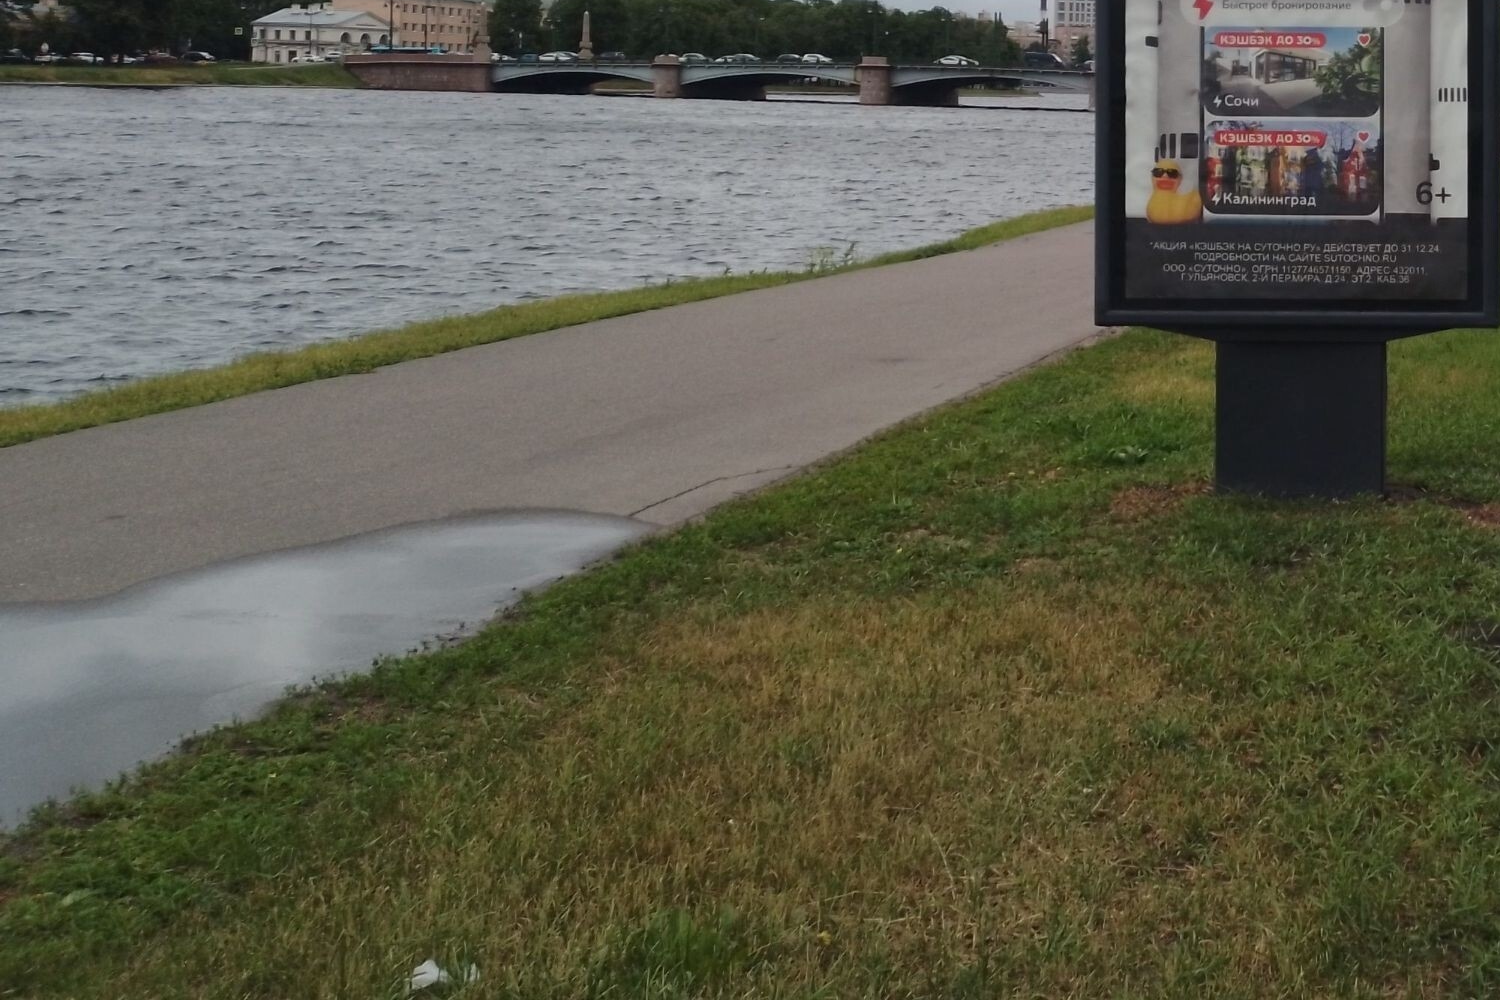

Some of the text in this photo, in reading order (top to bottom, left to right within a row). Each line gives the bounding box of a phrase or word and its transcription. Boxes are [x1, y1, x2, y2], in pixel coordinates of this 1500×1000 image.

[1222, 0, 1352, 11] Быстрое бронирование
[1219, 34, 1321, 46] КЭШБЭК ДО 30%
[1223, 94, 1259, 108] Сочи
[1219, 133, 1320, 145] КЭШБЭК ДО 30%
[1415, 180, 1452, 206] 6+
[1222, 192, 1317, 208] Калининград
[1189, 241, 1235, 252] «КЭШБЭК
[1237, 242, 1252, 251] НА
[1323, 243, 1381, 253] ДЕЙСТВУЕТ
[1383, 244, 1399, 254] ДО
[1194, 252, 1270, 262] ПОДРОБНОСТИ
[1272, 253, 1287, 262] НА
[1288, 252, 1322, 263] САЙТЕ
[1162, 263, 1186, 273] ООО
[1251, 264, 1279, 274] ОГРН
